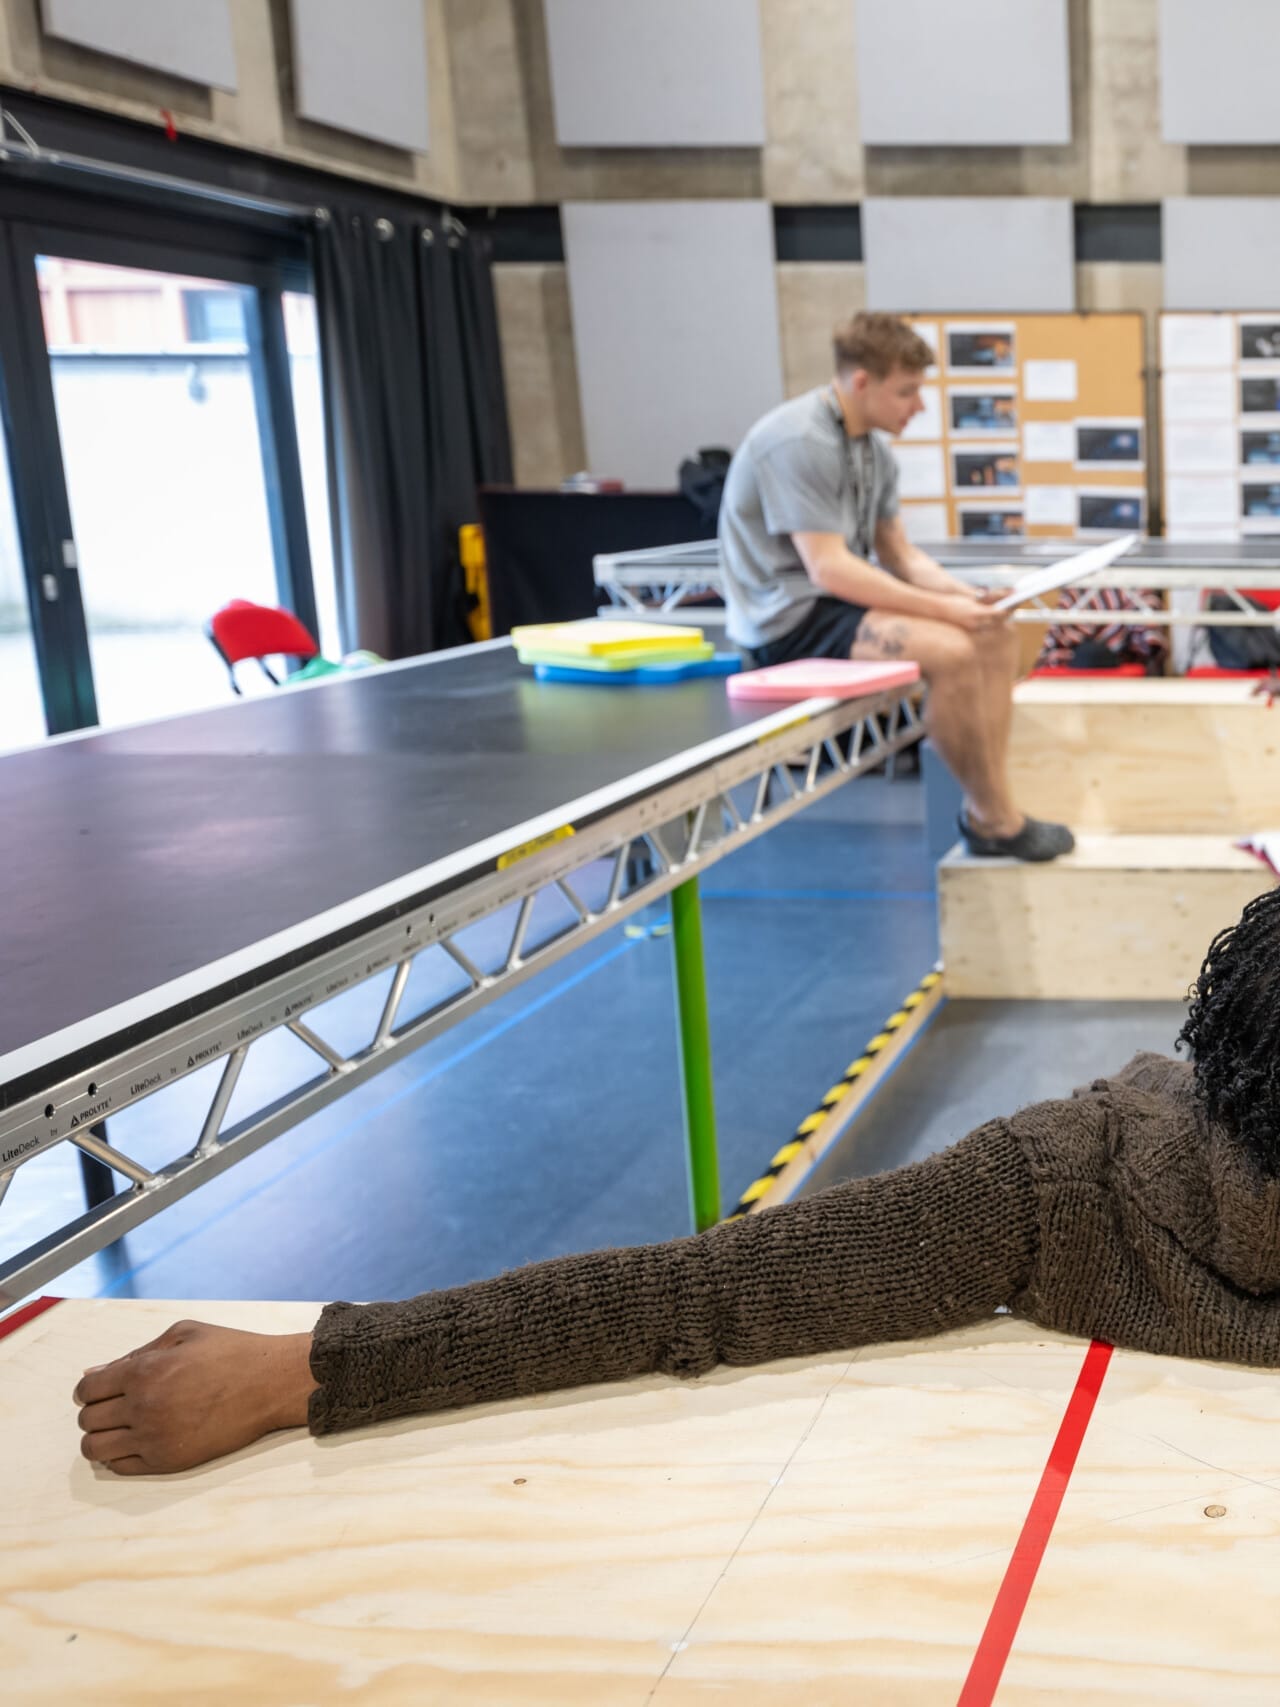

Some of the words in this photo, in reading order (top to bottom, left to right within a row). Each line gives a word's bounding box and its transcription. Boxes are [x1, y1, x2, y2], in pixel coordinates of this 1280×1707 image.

[2, 1136, 40, 1162] LiteDeck
[79, 1098, 111, 1121] PROLYTE
[130, 1074, 162, 1096] LiteDeck
